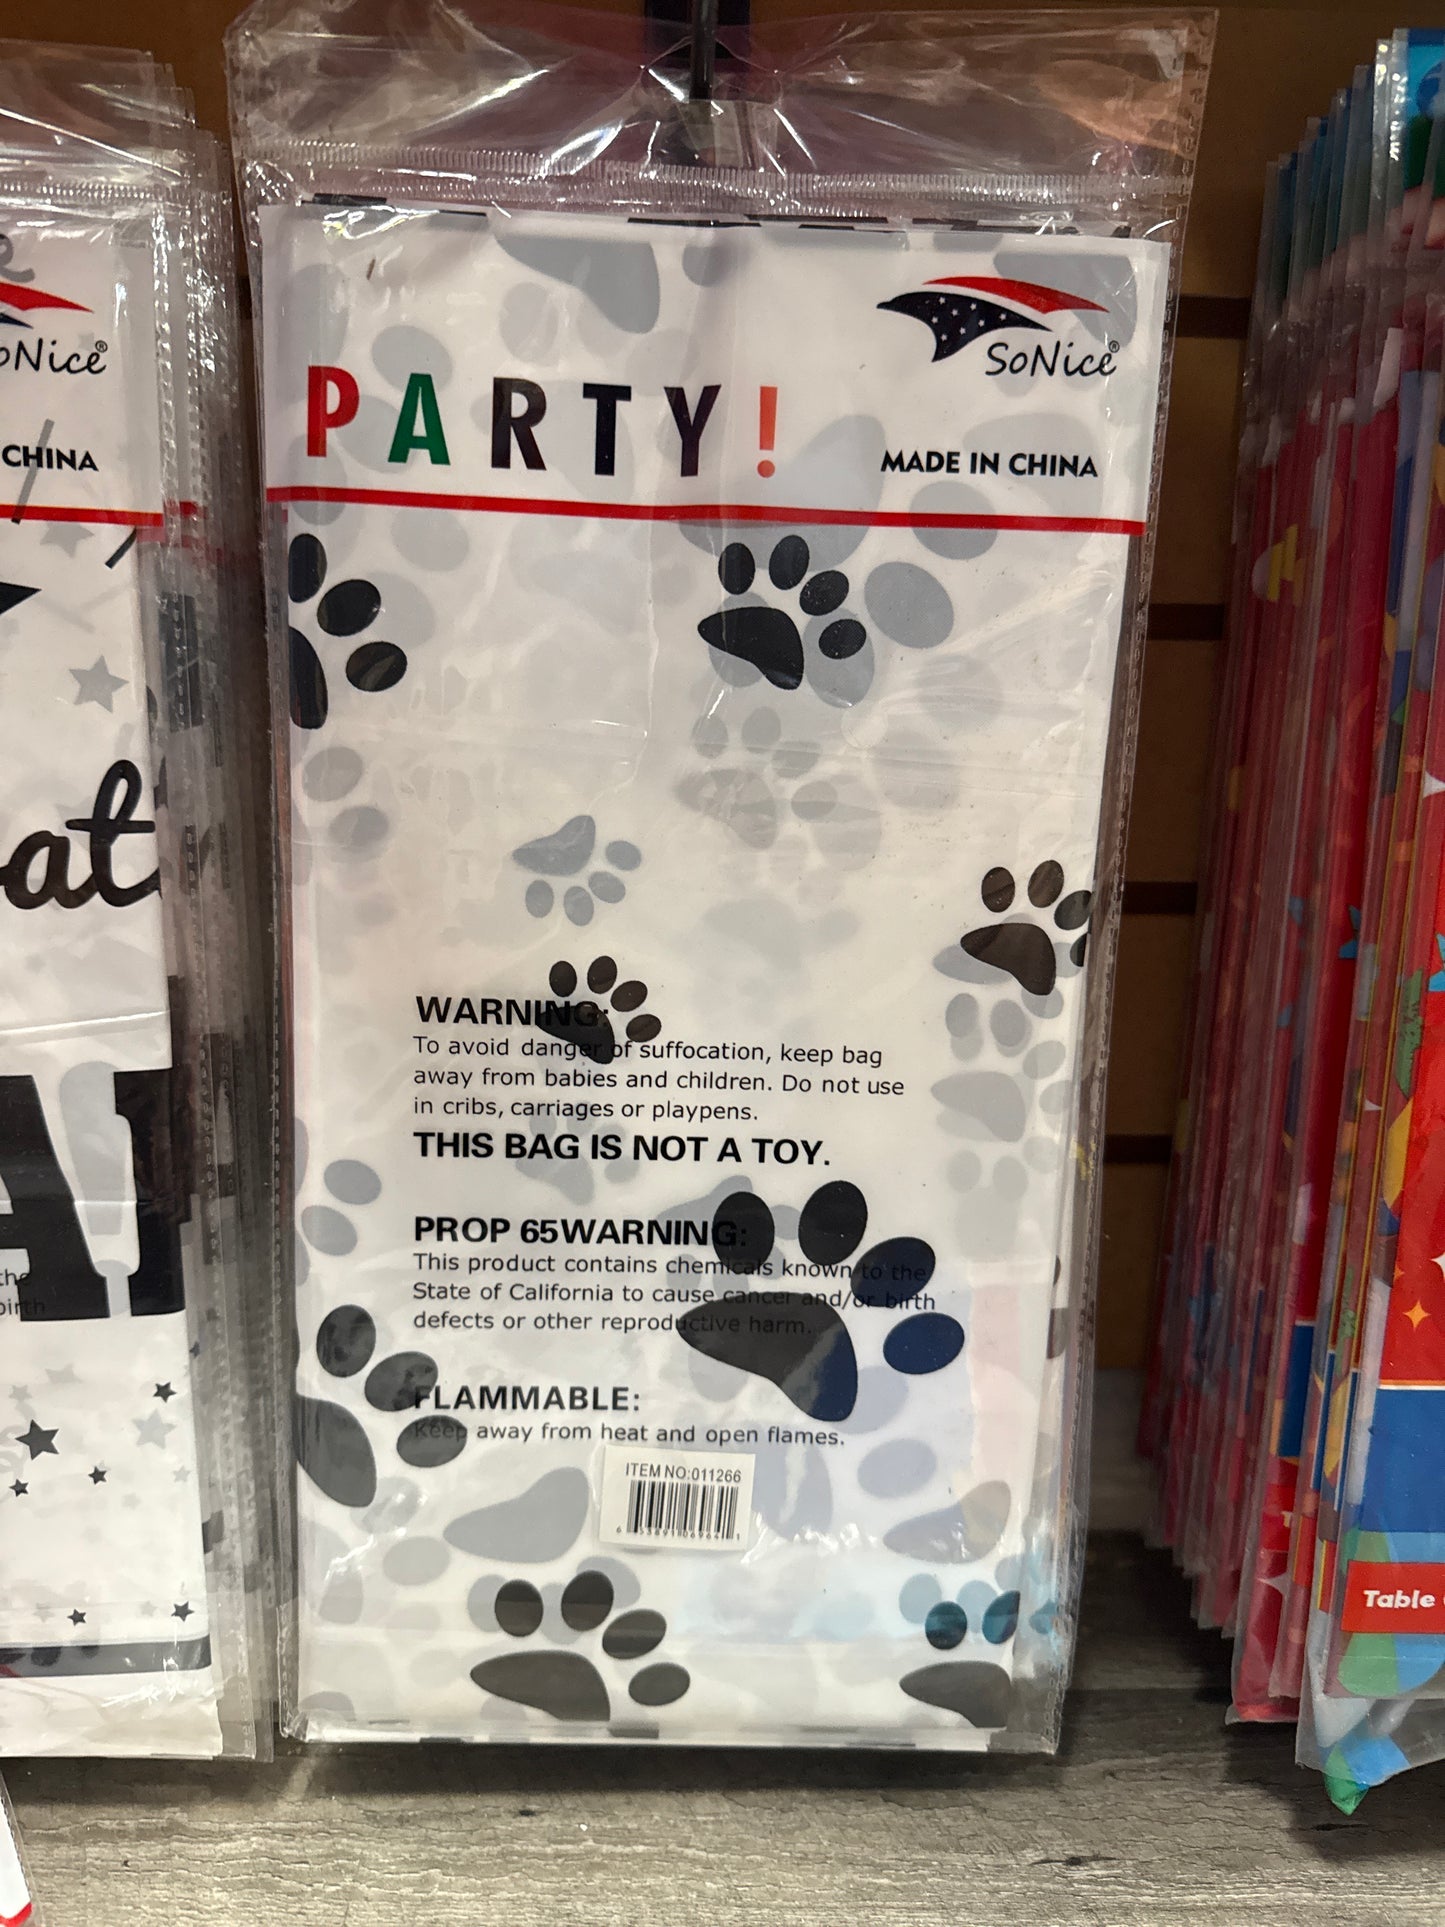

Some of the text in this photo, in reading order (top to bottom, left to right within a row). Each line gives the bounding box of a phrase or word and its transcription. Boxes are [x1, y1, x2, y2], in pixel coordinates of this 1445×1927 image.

[2, 444, 99, 471] CHINA
[880, 450, 1098, 478] MADE IN CHINA
[415, 996, 609, 1027] WARNING:
[413, 1036, 882, 1068] To avoid danger of suffocation, keep bag
[414, 1068, 904, 1095] away from babies and children. Do not use
[414, 1097, 758, 1123] in cribs, carriages or playpens.
[413, 1131, 830, 1165] THIS BAG IS NOT A TOY.
[415, 1216, 510, 1242] PROP
[414, 1253, 927, 1281] This product contains chemicals known to the
[413, 1282, 935, 1310] State of California to cause cancer and/or birth
[414, 1311, 812, 1334] defects or other reproductive harm.
[415, 1385, 640, 1411] FLAMMABLE:
[415, 1422, 844, 1445] Keep away from heat and open flames.
[626, 1463, 742, 1482] ITEM NO:011266
[1363, 1589, 1435, 1609] Table
